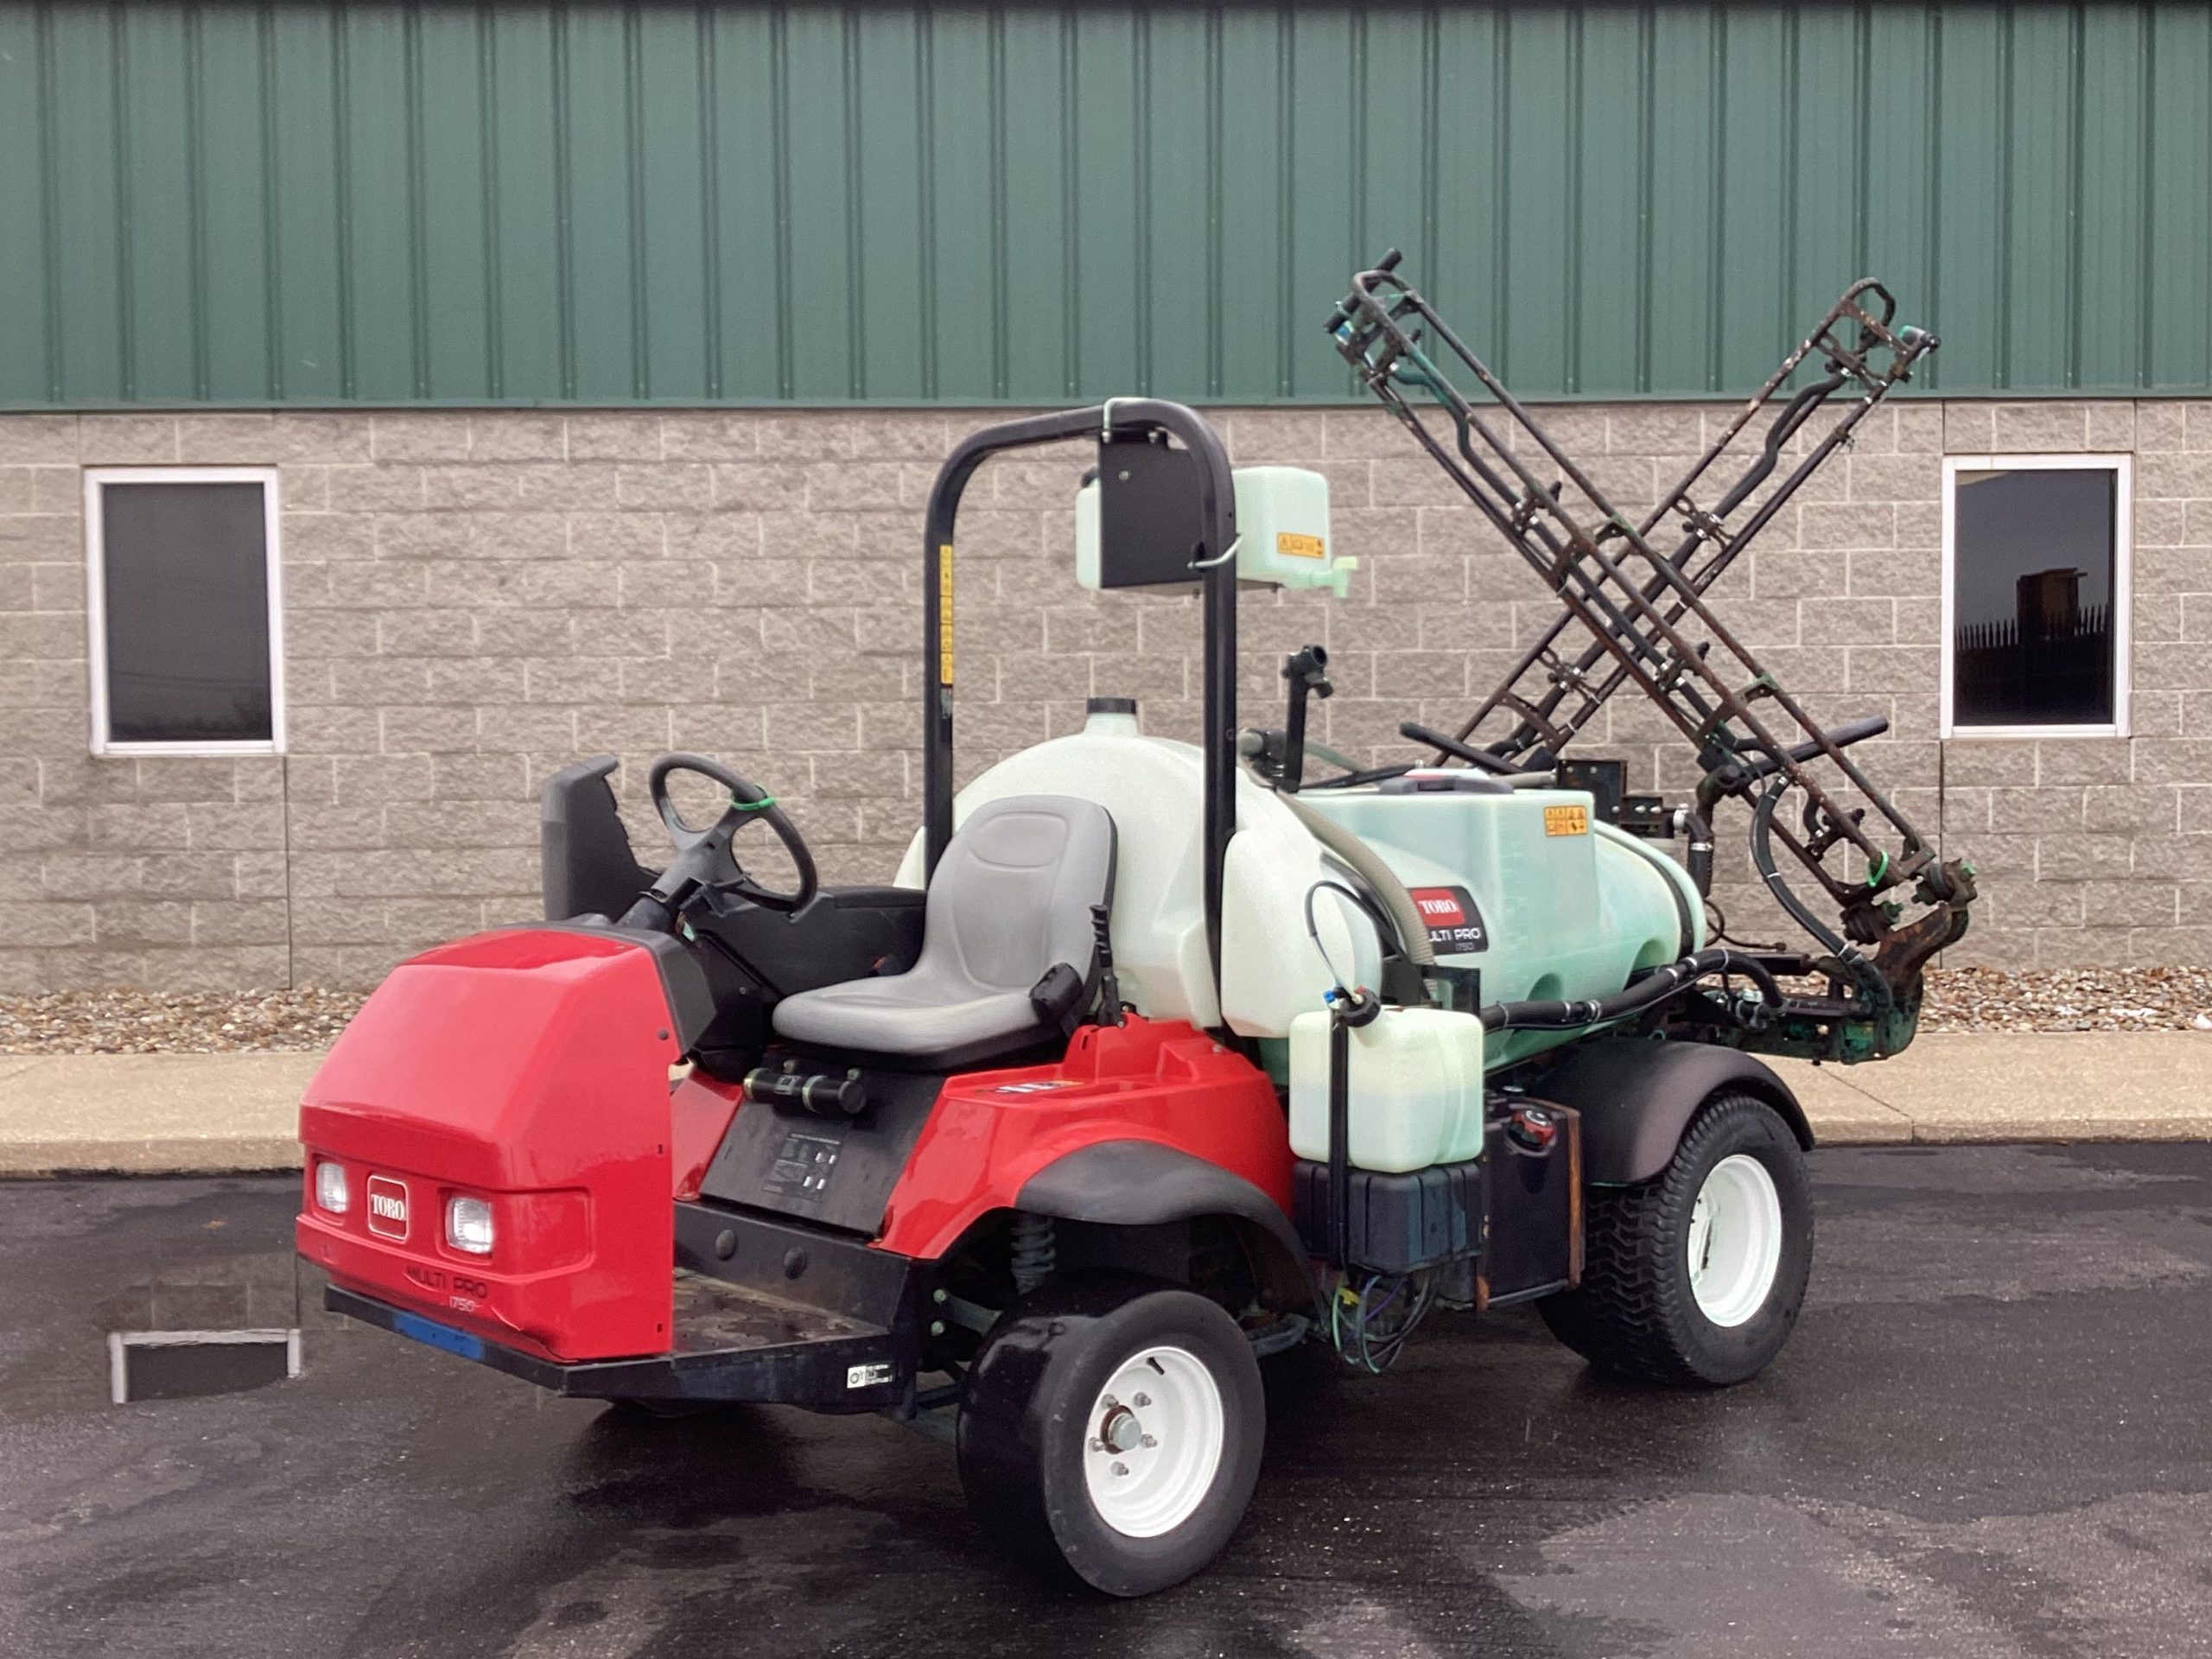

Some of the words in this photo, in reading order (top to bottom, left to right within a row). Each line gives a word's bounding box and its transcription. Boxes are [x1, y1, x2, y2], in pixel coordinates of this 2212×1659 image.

[1418, 899, 1458, 914] TORO
[1454, 928, 1481, 940] PRO
[371, 1193, 405, 1221] TORO
[406, 1265, 446, 1288] MULTI
[454, 1277, 488, 1299] PRO
[449, 1296, 475, 1312] 1750
